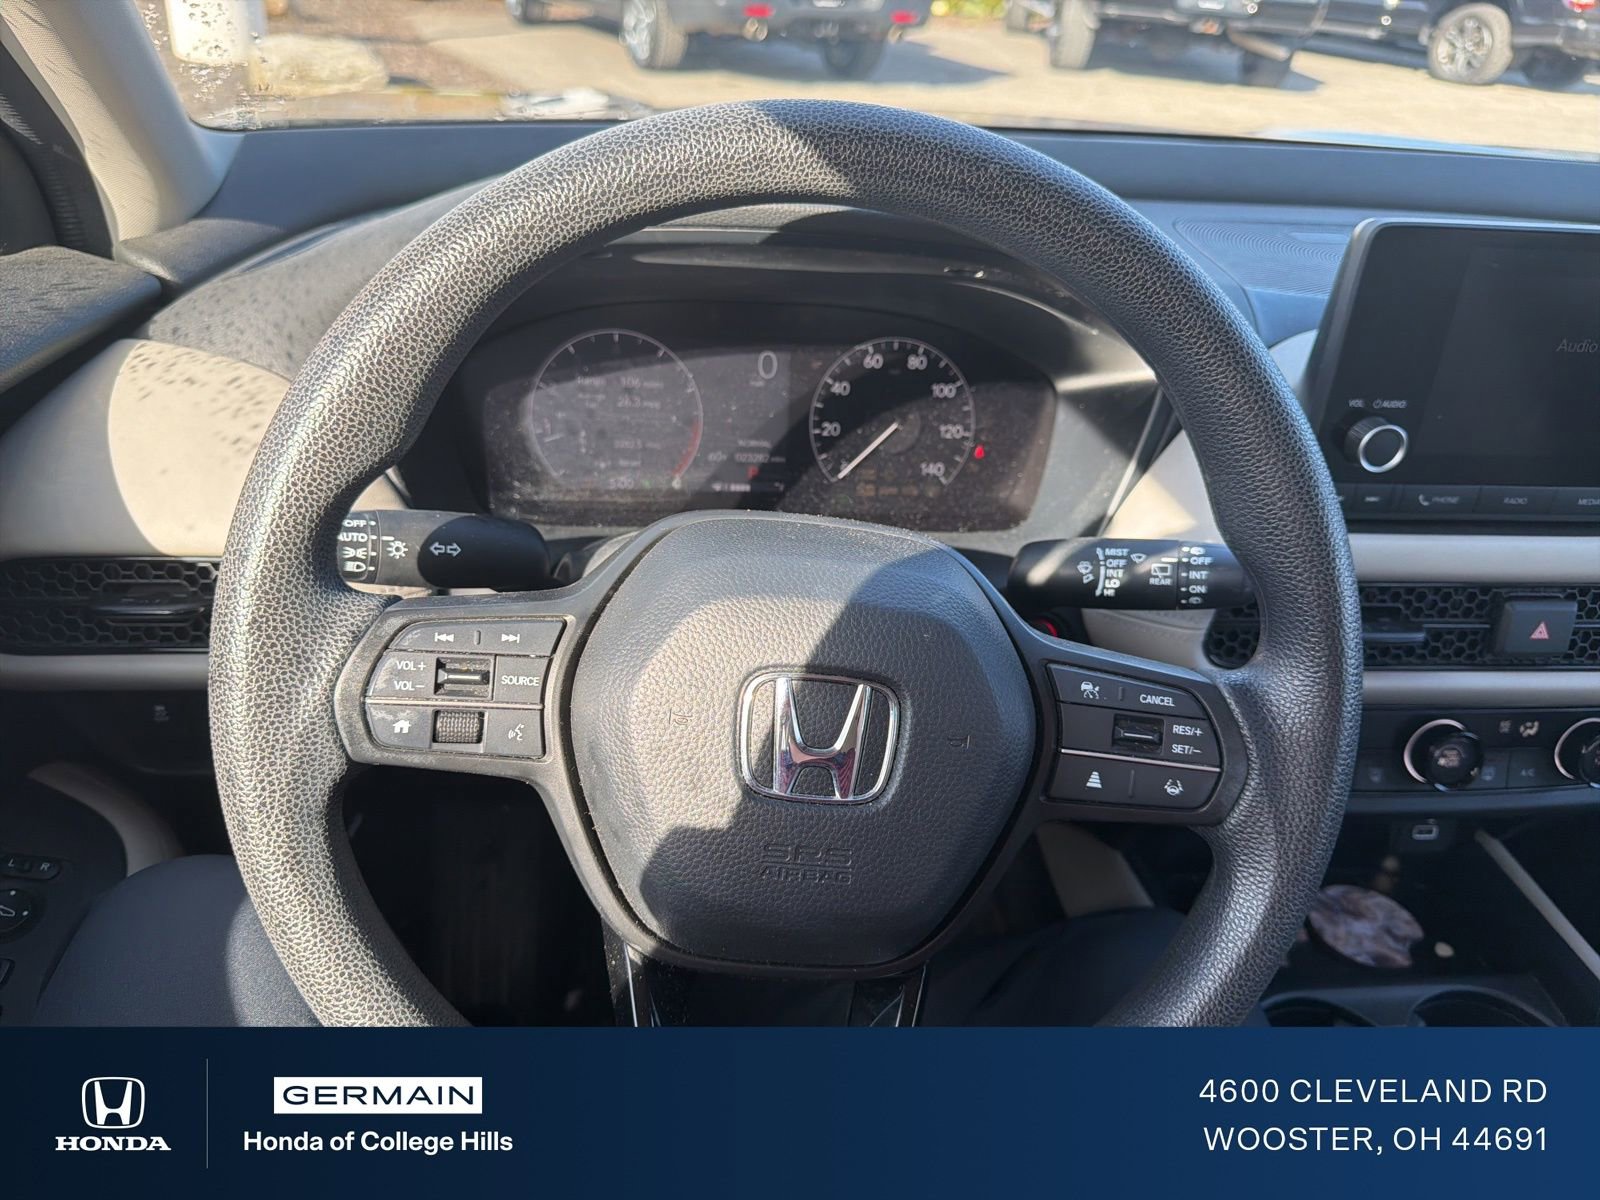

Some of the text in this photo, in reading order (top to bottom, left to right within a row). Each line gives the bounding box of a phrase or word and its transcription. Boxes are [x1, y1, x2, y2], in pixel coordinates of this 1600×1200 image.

[1557, 339, 1599, 352] Audio
[757, 351, 778, 379] 0
[863, 354, 884, 369] 60
[907, 354, 928, 370] 80
[830, 381, 851, 396] 40
[931, 383, 957, 399] 100
[1381, 400, 1407, 409] AUDIO
[821, 422, 841, 437] 20
[940, 424, 965, 440] 120
[920, 463, 945, 477] 140
[342, 519, 367, 528] OFF
[338, 532, 368, 543] AUTO
[1105, 548, 1129, 557] MIST
[1106, 559, 1127, 568] OFF
[1190, 557, 1213, 566] OFF
[1107, 569, 1124, 578] INT
[1189, 570, 1208, 580] INT
[1105, 579, 1121, 589] LO
[1149, 578, 1171, 586] REAR
[1189, 585, 1207, 594] ON
[501, 676, 540, 687] SOURCE
[1139, 694, 1176, 707] CANCEL
[1172, 724, 1204, 737] RES/+
[8, 858, 15, 868] L
[40, 862, 50, 871] R
